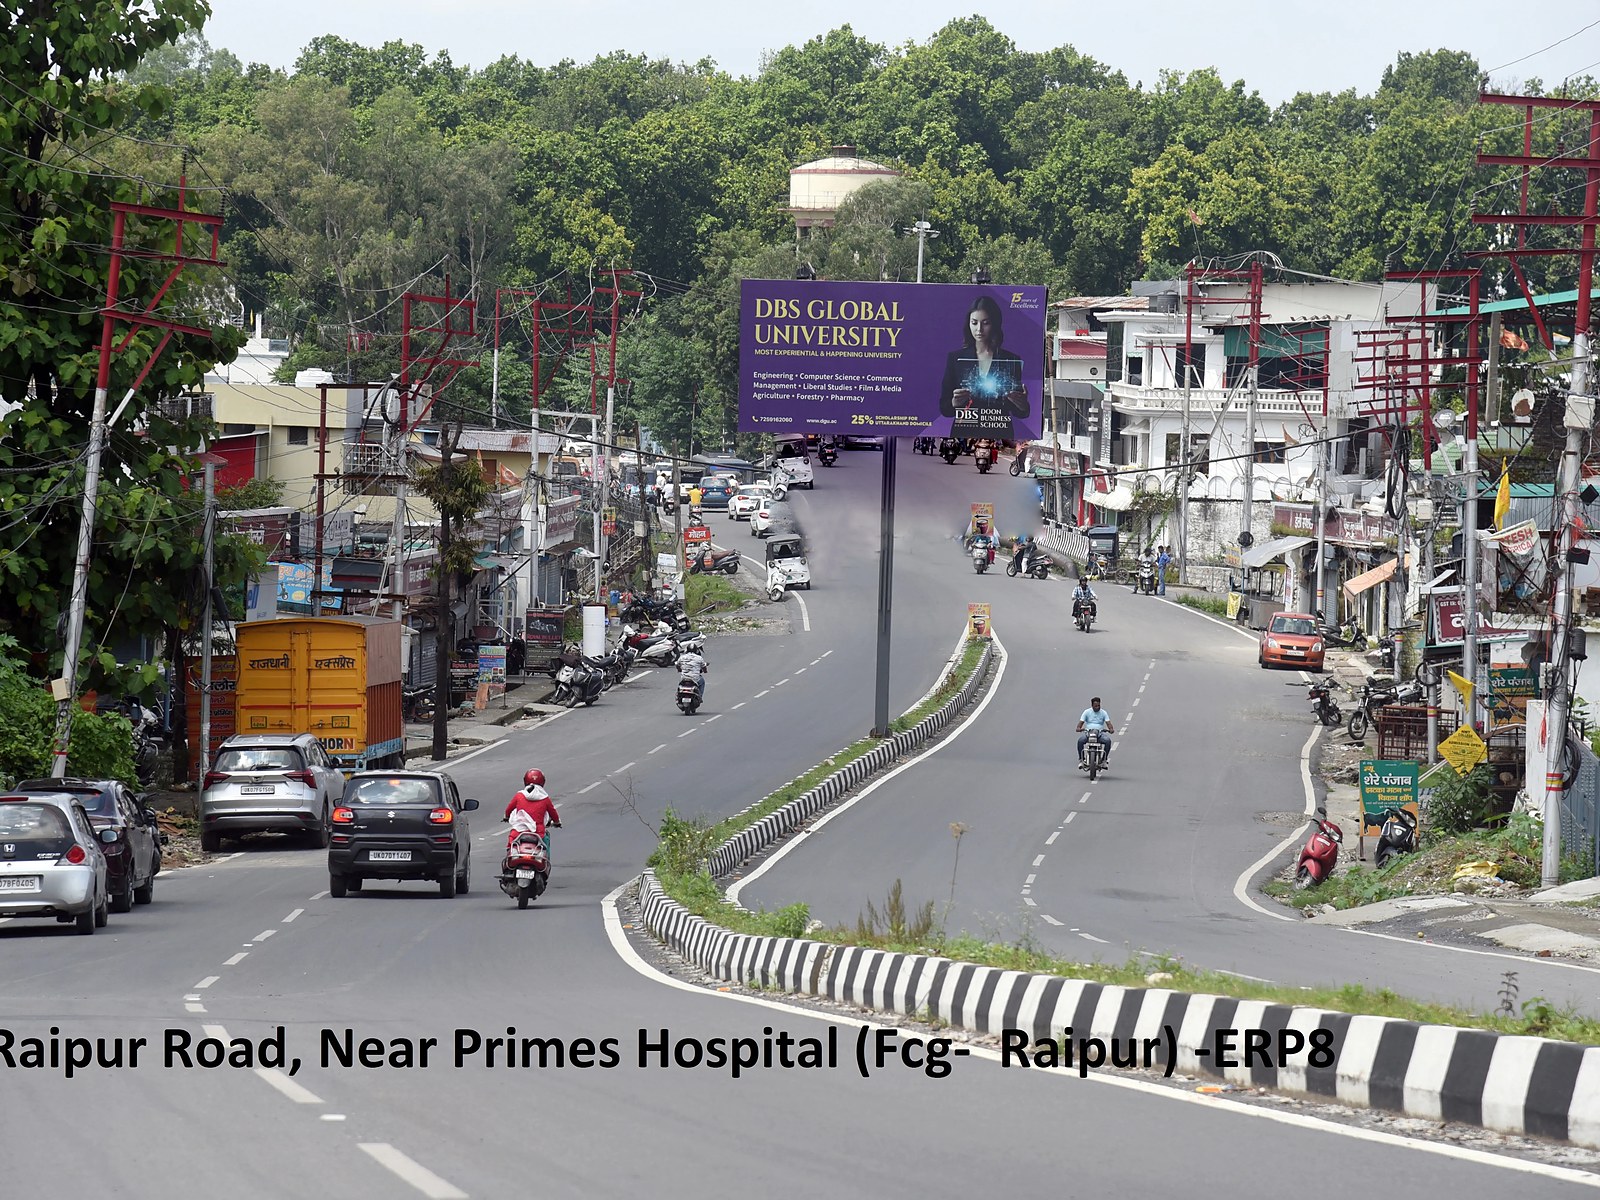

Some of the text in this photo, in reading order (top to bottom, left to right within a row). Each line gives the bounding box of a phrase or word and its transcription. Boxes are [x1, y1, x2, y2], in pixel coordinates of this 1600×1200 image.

[1011, 292, 1024, 302] 15
[755, 298, 905, 322] DBS GLOBAL
[755, 324, 902, 347] UNIVERSITY
[753, 372, 903, 382] Engineering Computer Science Commerce
[753, 382, 797, 390] Management
[827, 383, 853, 391] Studies
[752, 392, 865, 403] Agriculture Forestry Pharmacy
[851, 414, 874, 425] 25%
[955, 409, 979, 420] DBS
[249, 653, 290, 669] राजधानी
[314, 654, 356, 669] एक्सप्रेस
[1491, 677, 1506, 687] शेरे
[319, 738, 354, 750] HORN
[1363, 772, 1412, 785] शेरे पंजाब
